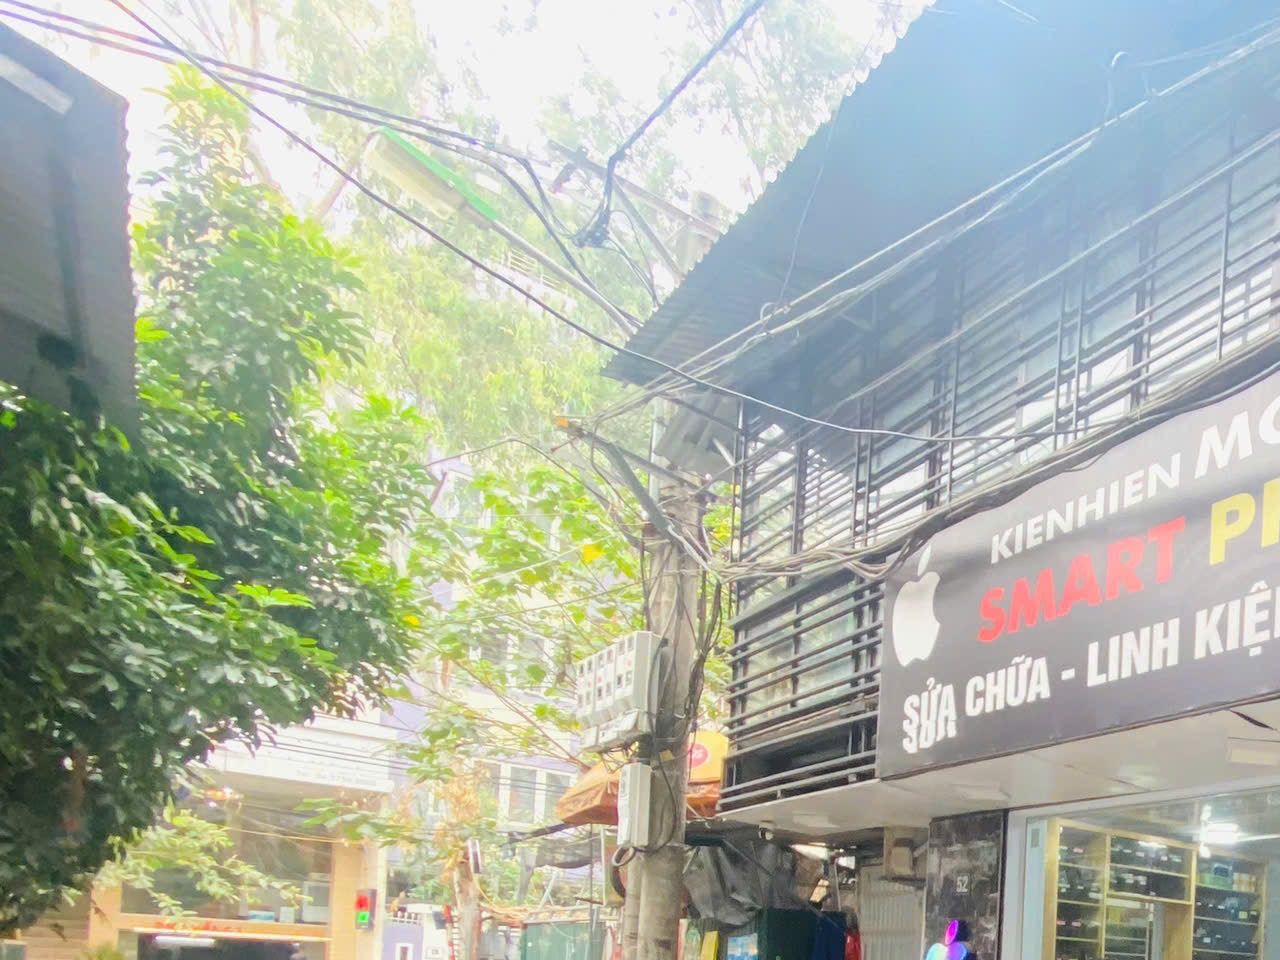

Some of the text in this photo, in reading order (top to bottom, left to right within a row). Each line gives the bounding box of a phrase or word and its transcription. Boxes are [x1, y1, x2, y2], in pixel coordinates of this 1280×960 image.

[991, 453, 1181, 564] KIENHIEN
[977, 517, 1186, 643] SMART
[902, 677, 957, 753] SỬA
[966, 655, 1050, 718] CHỮA
[1087, 618, 1180, 687] LINH
[956, 875, 969, 893] 52
